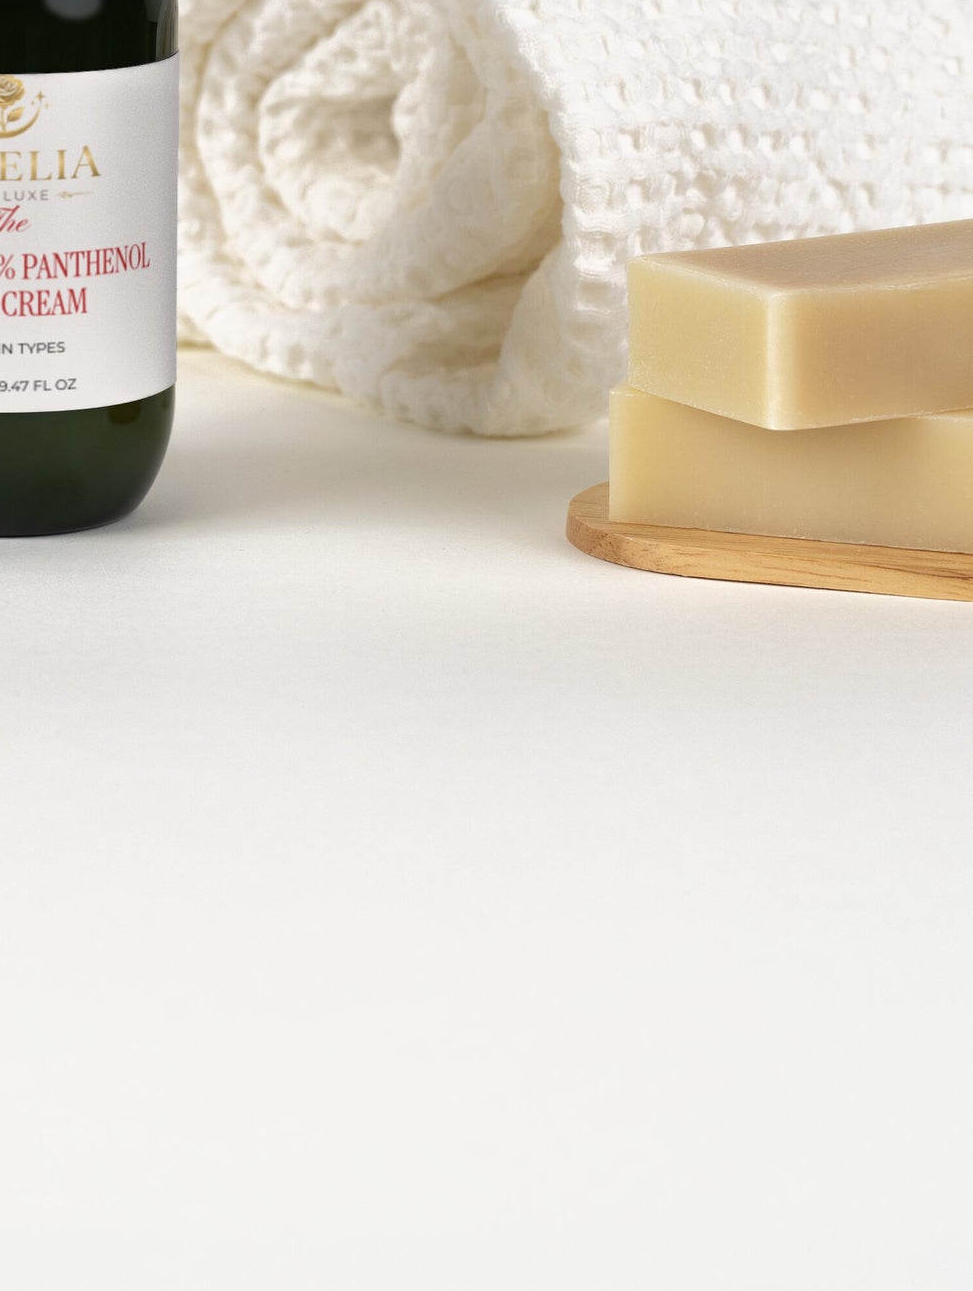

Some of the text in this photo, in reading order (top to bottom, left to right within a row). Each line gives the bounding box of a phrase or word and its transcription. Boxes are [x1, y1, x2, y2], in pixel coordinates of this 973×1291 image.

[3, 189, 49, 201] LUXE
[22, 242, 151, 280] PANTHENOL
[1, 287, 88, 317] CREAM
[18, 341, 66, 355] TYPES
[33, 379, 52, 392] FL
[55, 378, 77, 391] OZ
